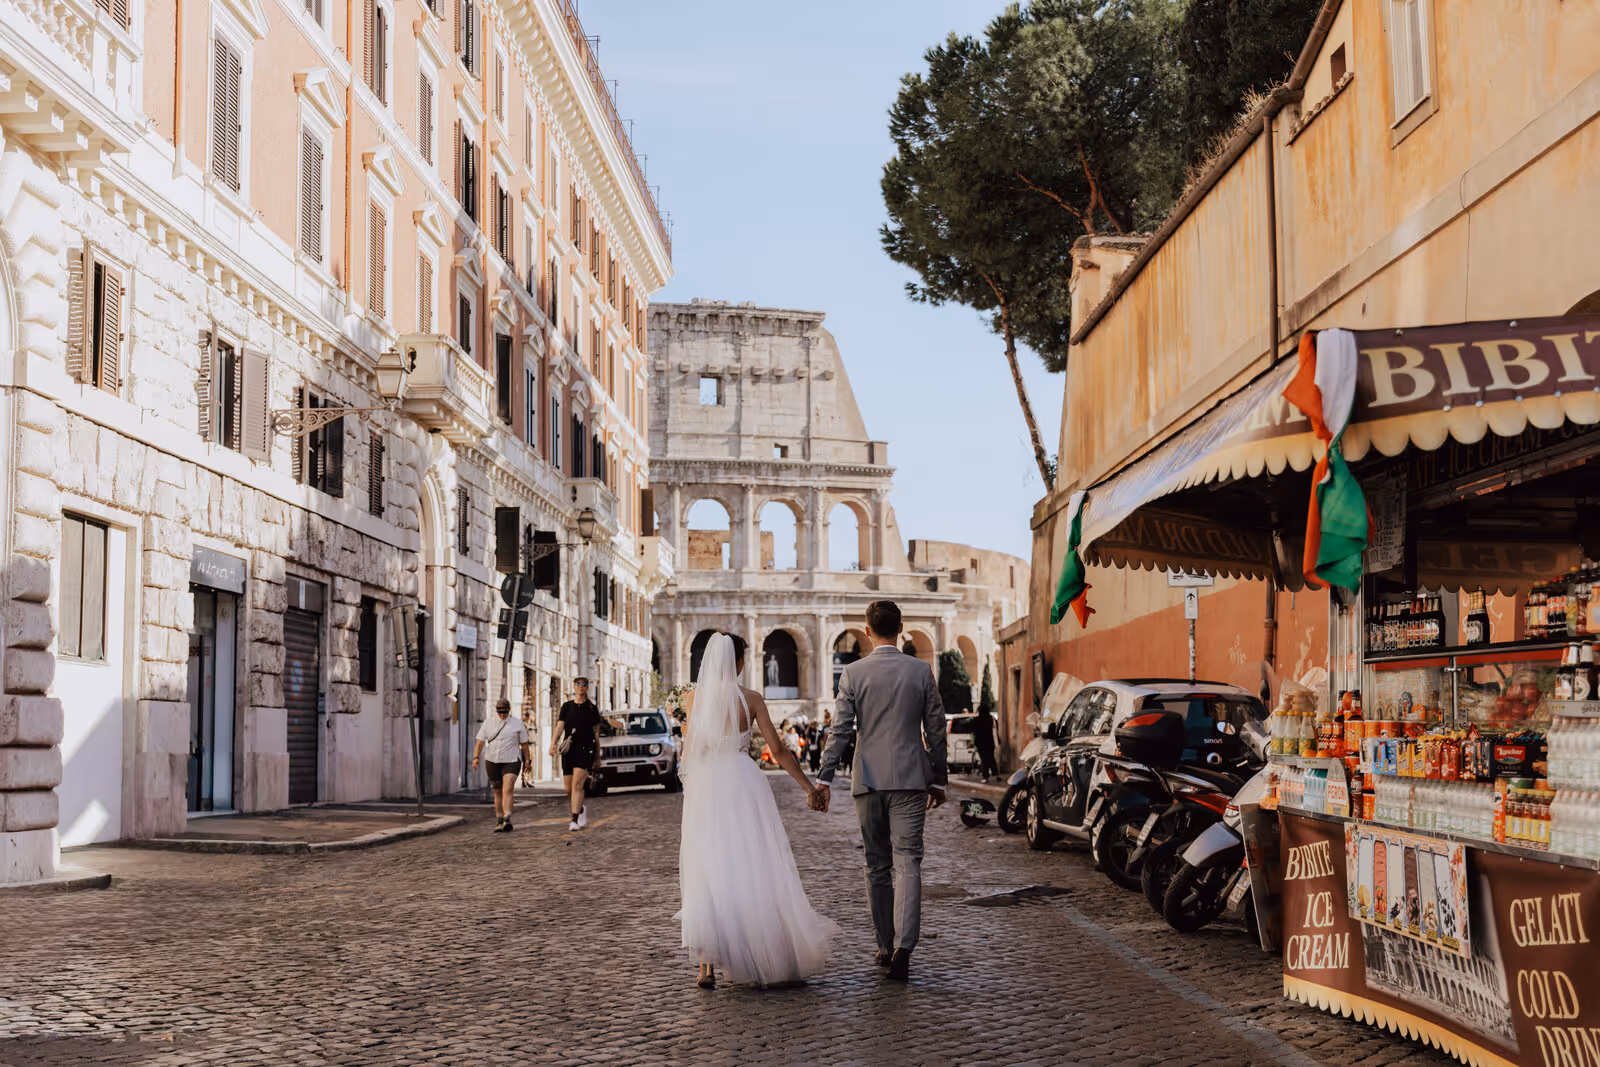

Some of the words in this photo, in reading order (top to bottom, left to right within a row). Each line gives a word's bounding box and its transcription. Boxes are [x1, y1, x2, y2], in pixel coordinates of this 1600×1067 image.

[1284, 840, 1334, 881] BIBITE
[1302, 891, 1335, 928] ICE
[1510, 892, 1590, 947] GELATI
[1286, 932, 1349, 970] CREAM
[1517, 969, 1580, 1019] COLD
